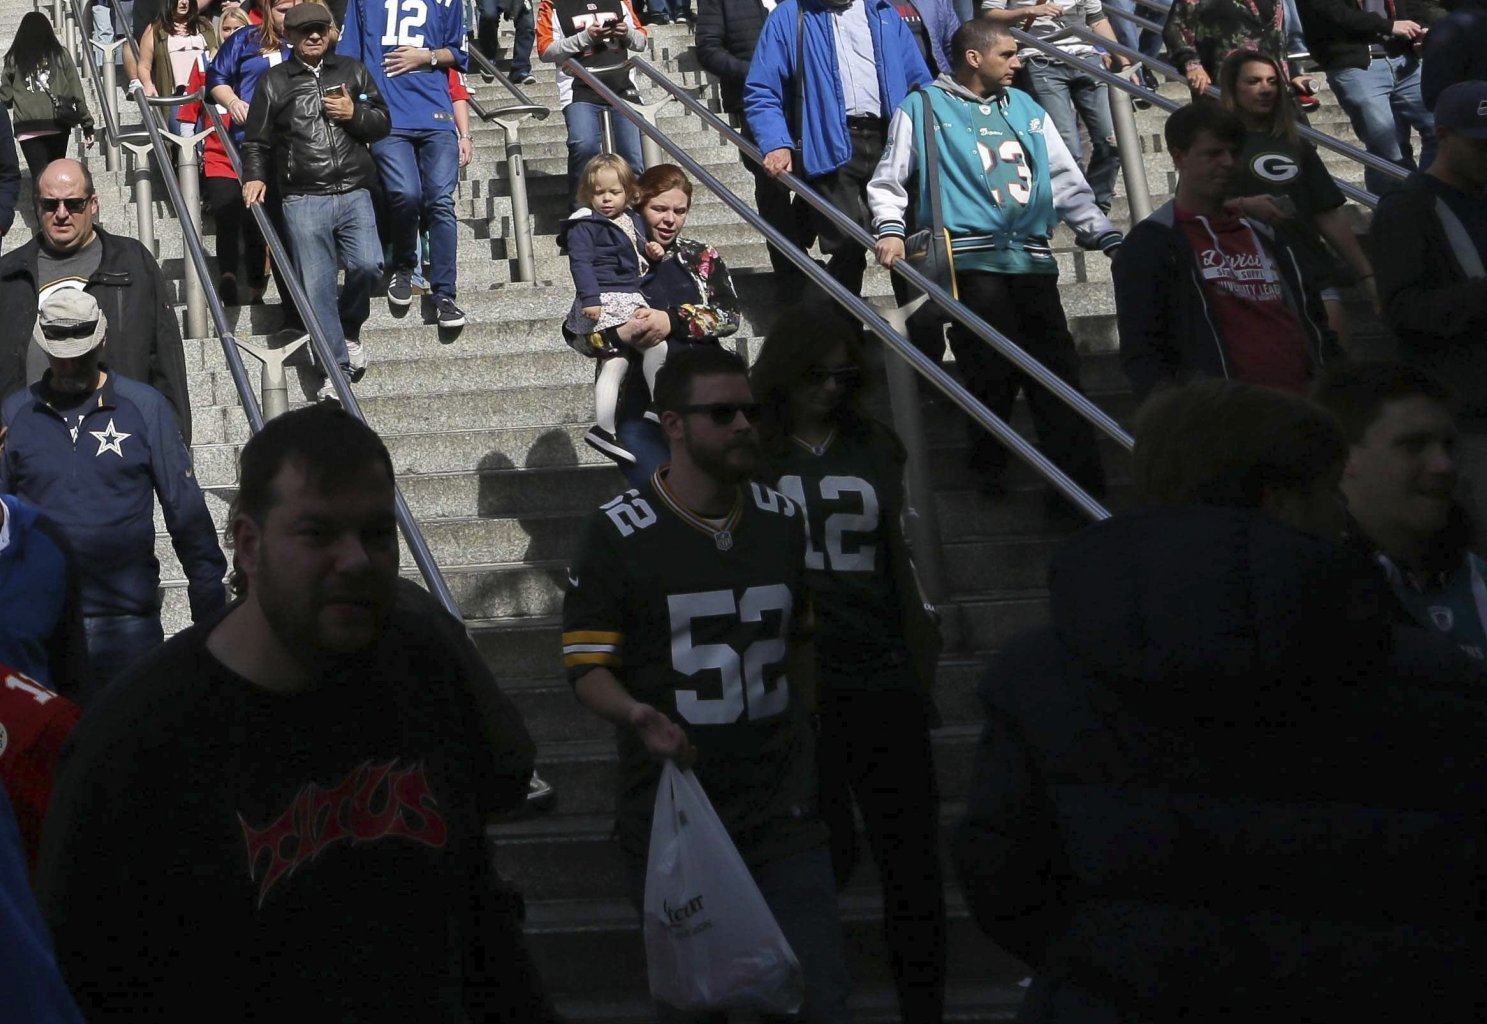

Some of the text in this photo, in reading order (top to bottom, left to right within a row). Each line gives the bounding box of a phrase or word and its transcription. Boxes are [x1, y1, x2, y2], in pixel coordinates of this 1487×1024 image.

[1253, 154, 1299, 181] G
[777, 475, 880, 572] 12
[666, 583, 793, 724] 52
[5, 671, 58, 706] 1
